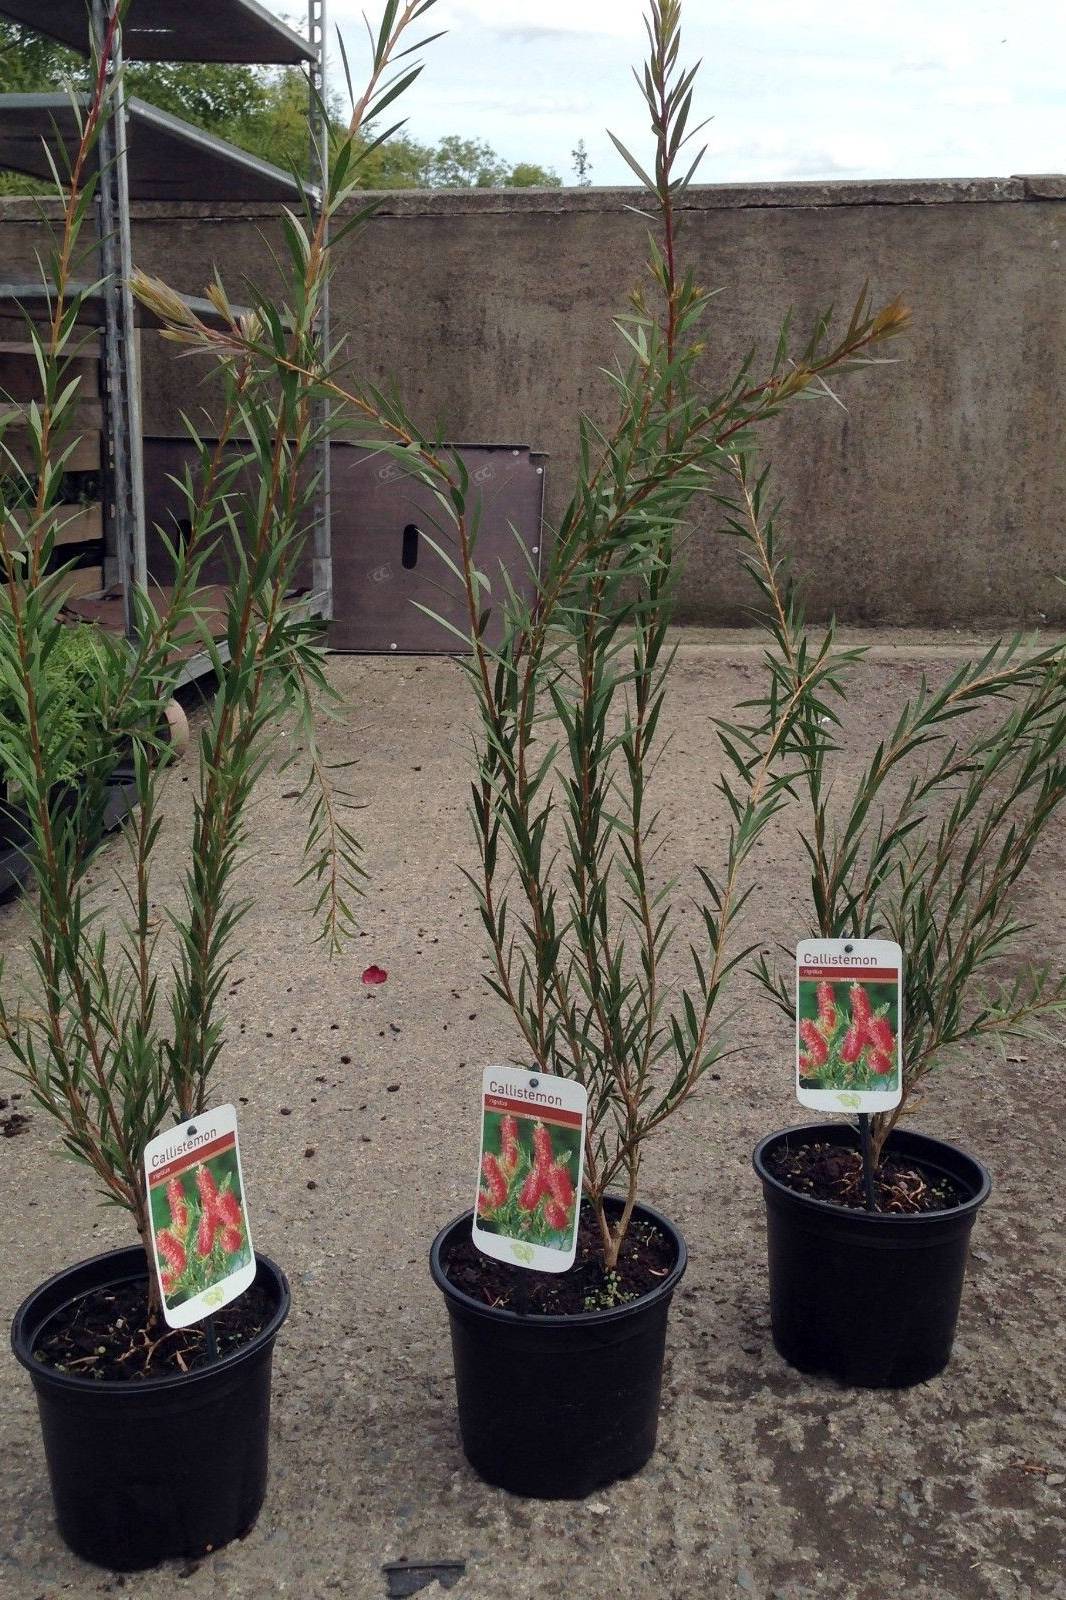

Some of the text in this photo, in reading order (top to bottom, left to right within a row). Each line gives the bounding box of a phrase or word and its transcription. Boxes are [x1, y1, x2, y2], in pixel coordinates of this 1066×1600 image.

[803, 953, 878, 966] Callistemon
[489, 1080, 563, 1106] Callistemon
[151, 1128, 218, 1168] Callistemon
